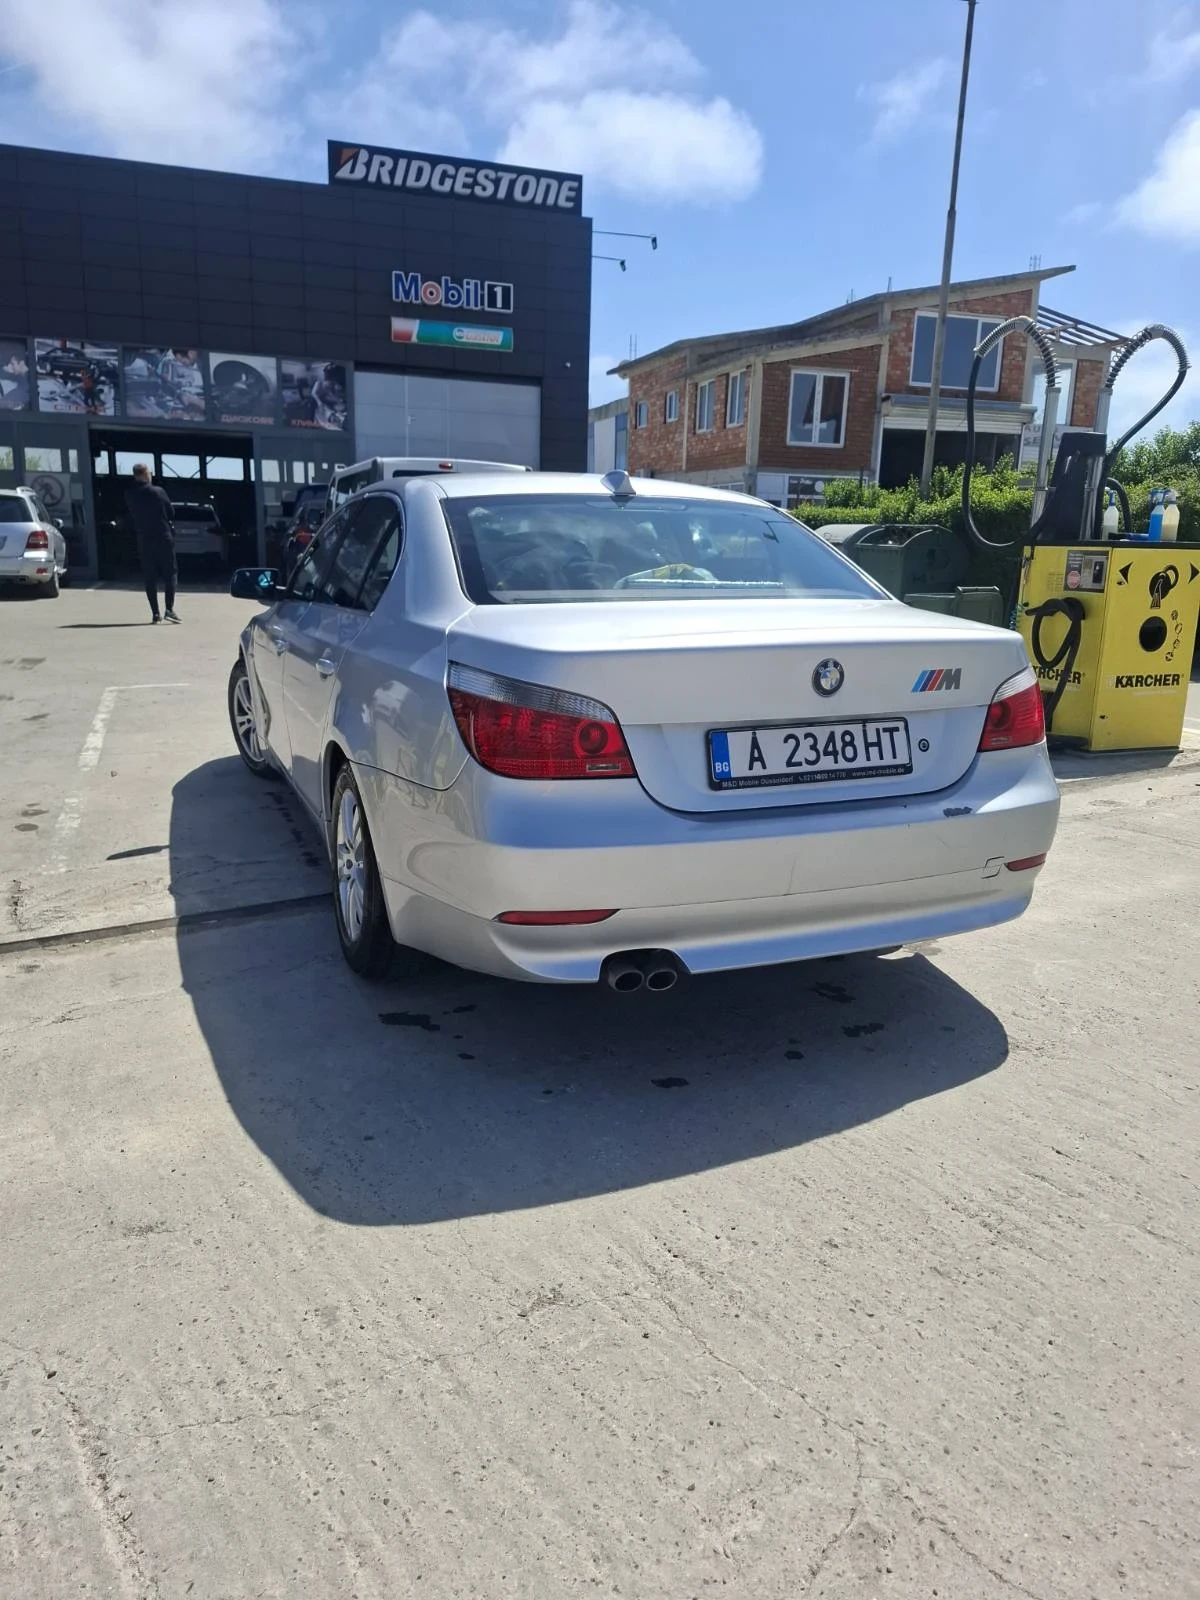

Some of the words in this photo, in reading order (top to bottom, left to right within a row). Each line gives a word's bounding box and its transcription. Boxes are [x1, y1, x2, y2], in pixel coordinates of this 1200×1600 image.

[334, 147, 579, 208] BRIDGESTONE
[392, 270, 481, 310] Mobil
[1115, 673, 1181, 689] KÄRCHER
[714, 760, 729, 773] BG
[782, 729, 858, 768] 2348
[862, 725, 900, 762] HT
